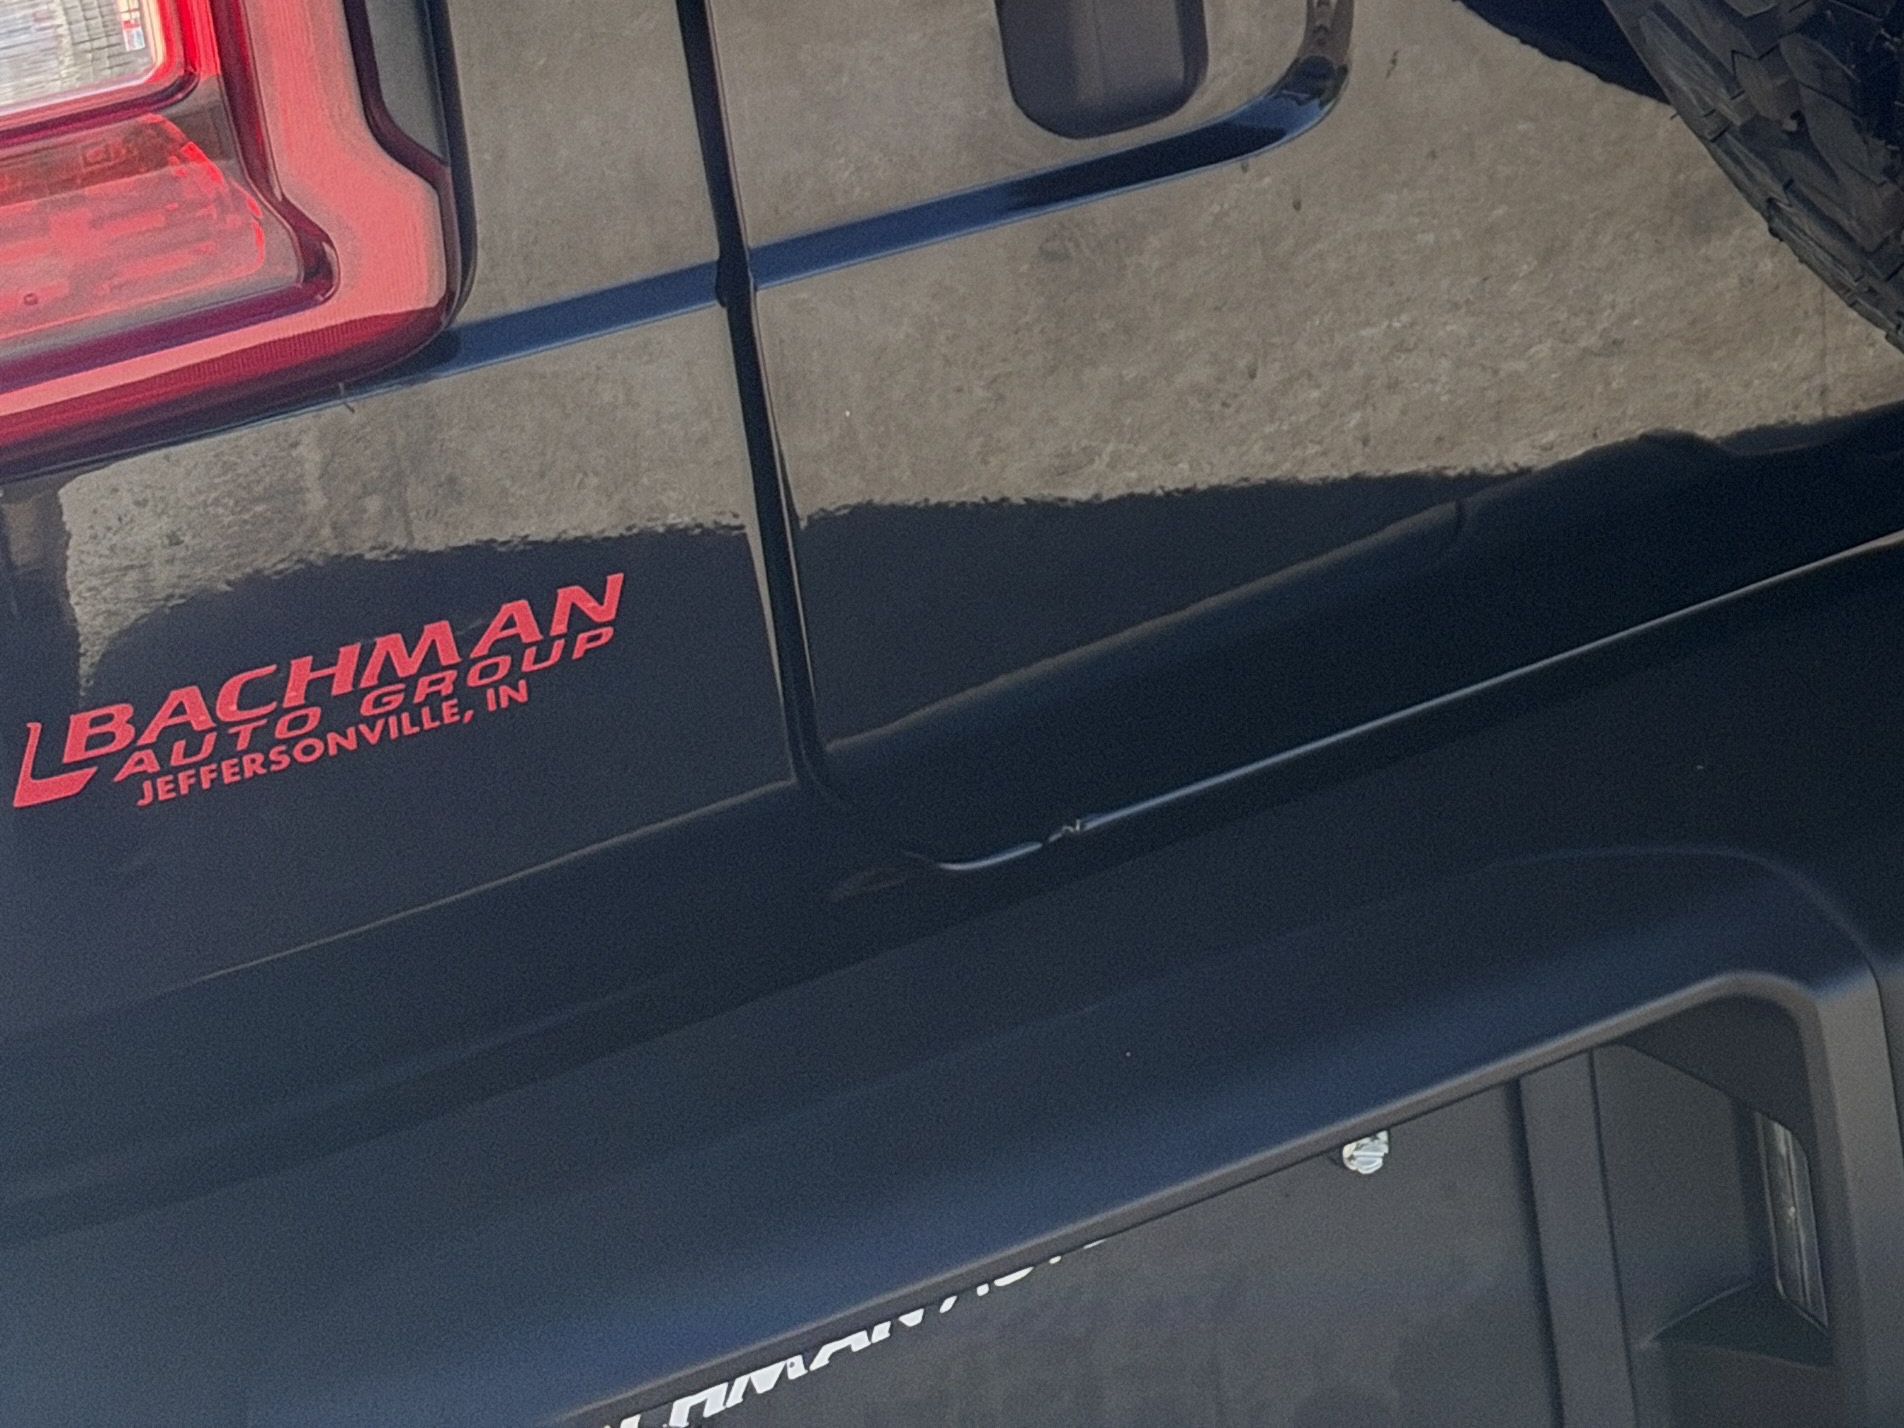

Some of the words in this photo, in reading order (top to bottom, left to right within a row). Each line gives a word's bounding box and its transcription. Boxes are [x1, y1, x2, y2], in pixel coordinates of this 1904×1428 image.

[62, 572, 625, 763] BACHMAN
[113, 705, 322, 784] AUTO
[360, 625, 617, 717] GROUP
[136, 702, 474, 806] JEFFERSONVILLE,
[486, 679, 530, 713] IN
